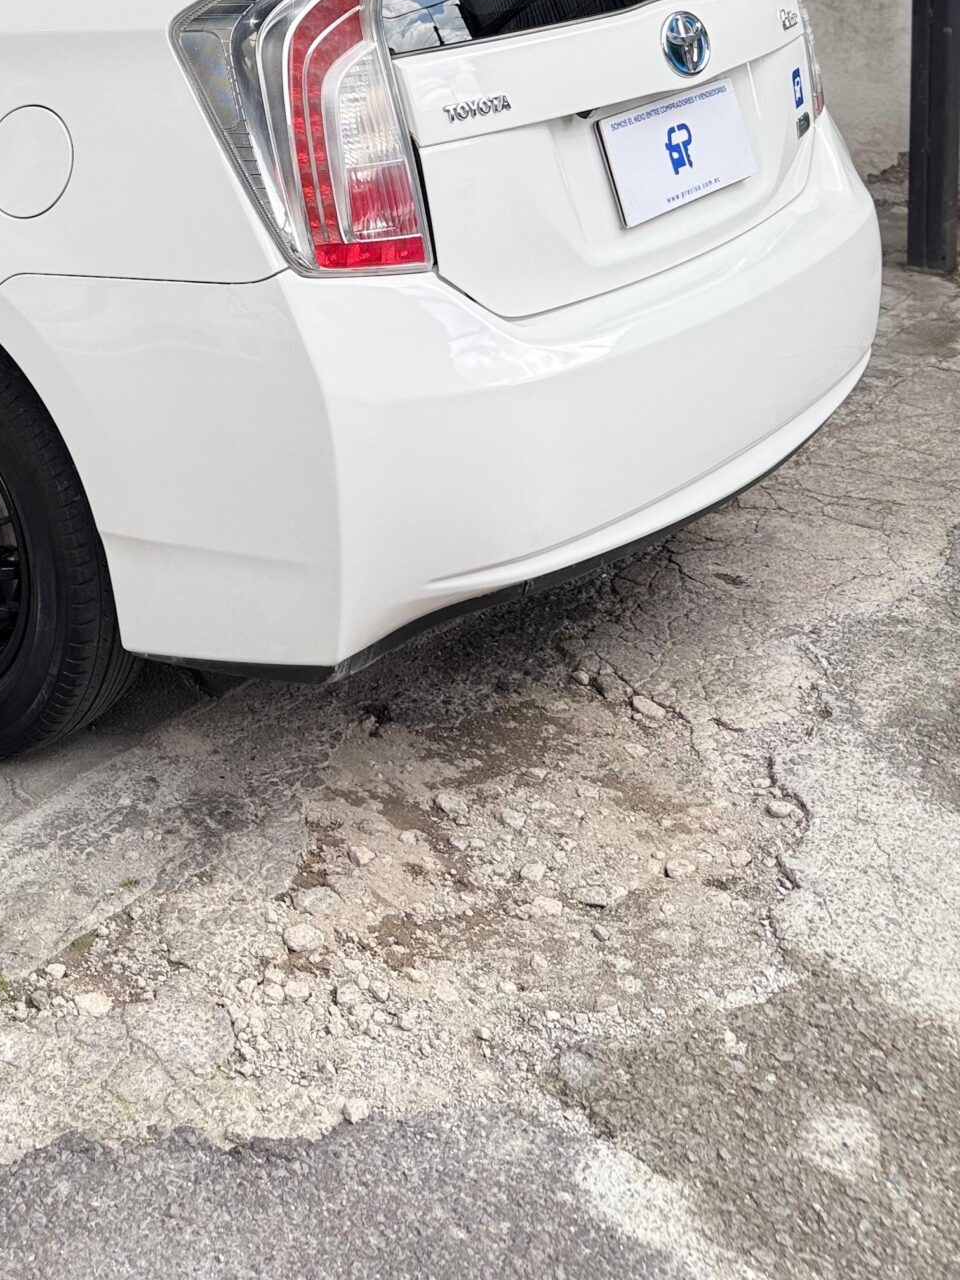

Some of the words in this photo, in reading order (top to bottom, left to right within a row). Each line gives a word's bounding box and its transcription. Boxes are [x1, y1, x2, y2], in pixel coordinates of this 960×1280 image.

[443, 95, 512, 123] TOYOTA
[610, 119, 628, 131] SOMOS
[646, 108, 660, 119] ENTRE
[660, 96, 694, 114] COMPRADORES
[698, 85, 727, 101] VENDEDORES
